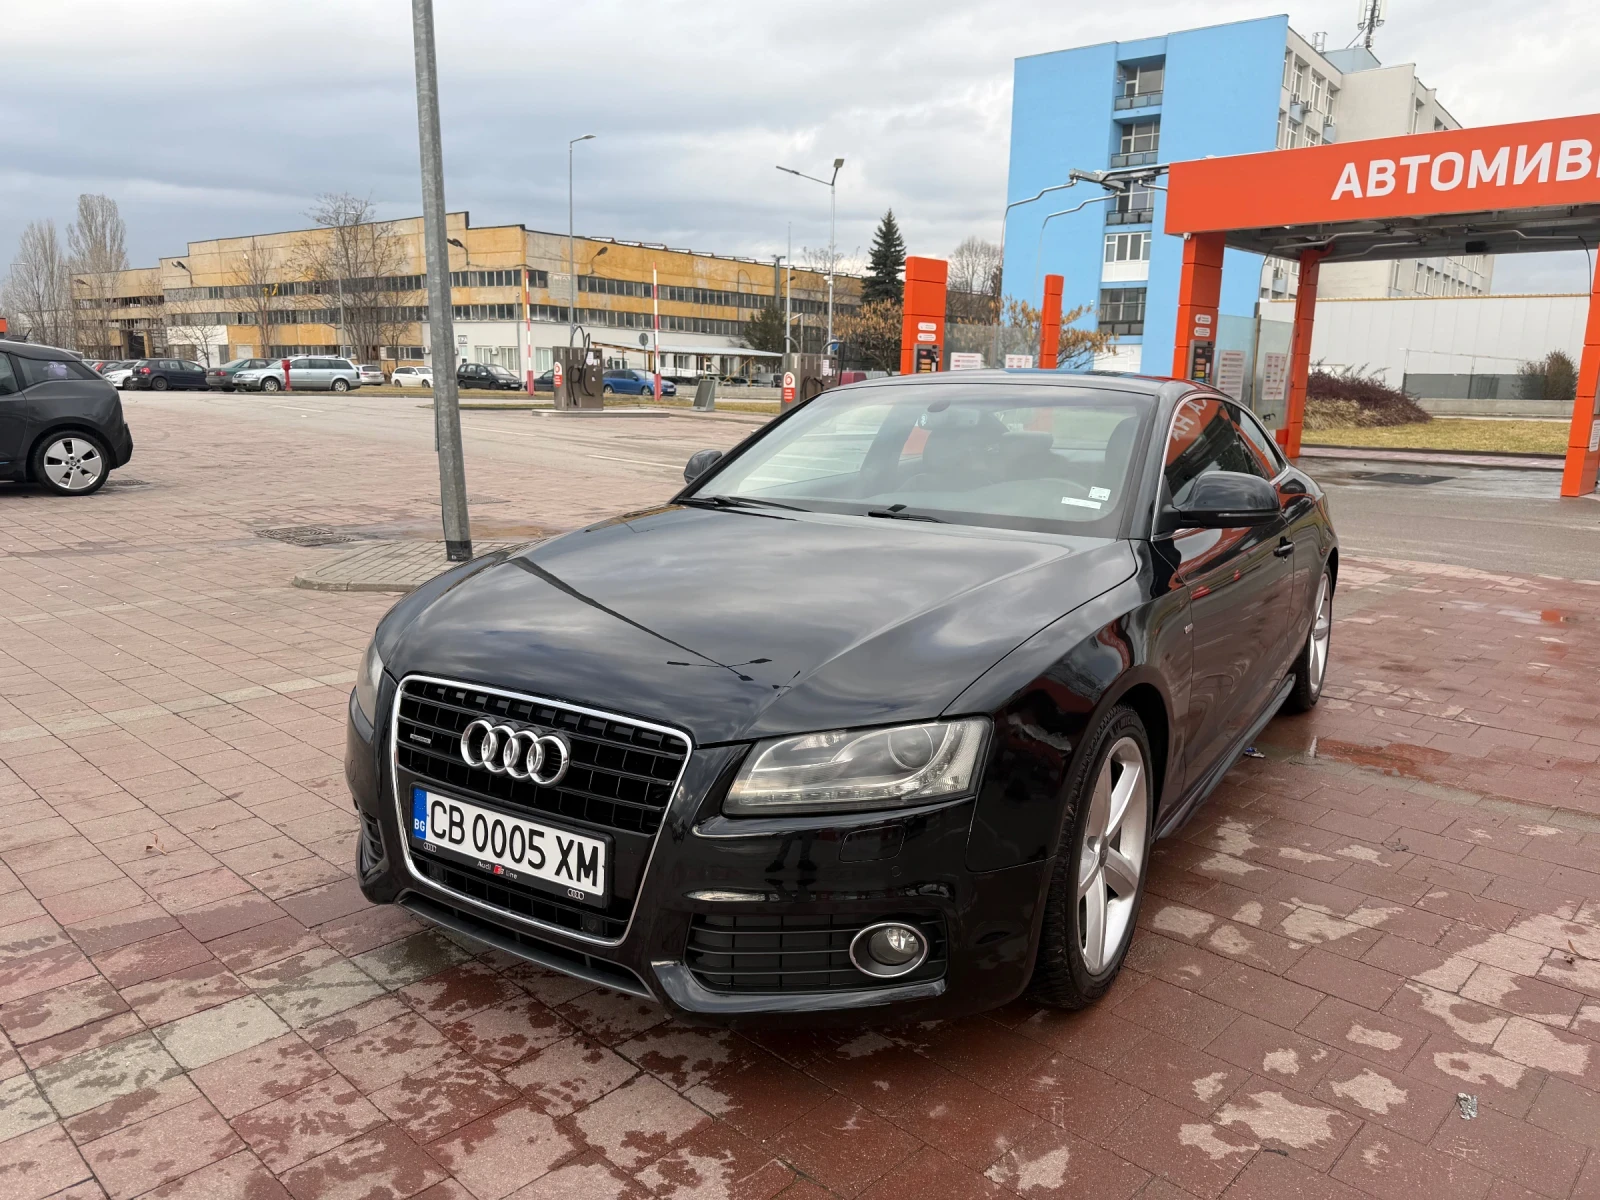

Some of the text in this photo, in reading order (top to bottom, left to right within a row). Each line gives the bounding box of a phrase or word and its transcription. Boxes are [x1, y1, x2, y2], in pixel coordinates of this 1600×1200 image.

[1330, 138, 1600, 201] АВТОМИВ
[414, 818, 426, 832] BG
[430, 800, 599, 887] CB 0005 XM
[477, 861, 492, 871] Audi
